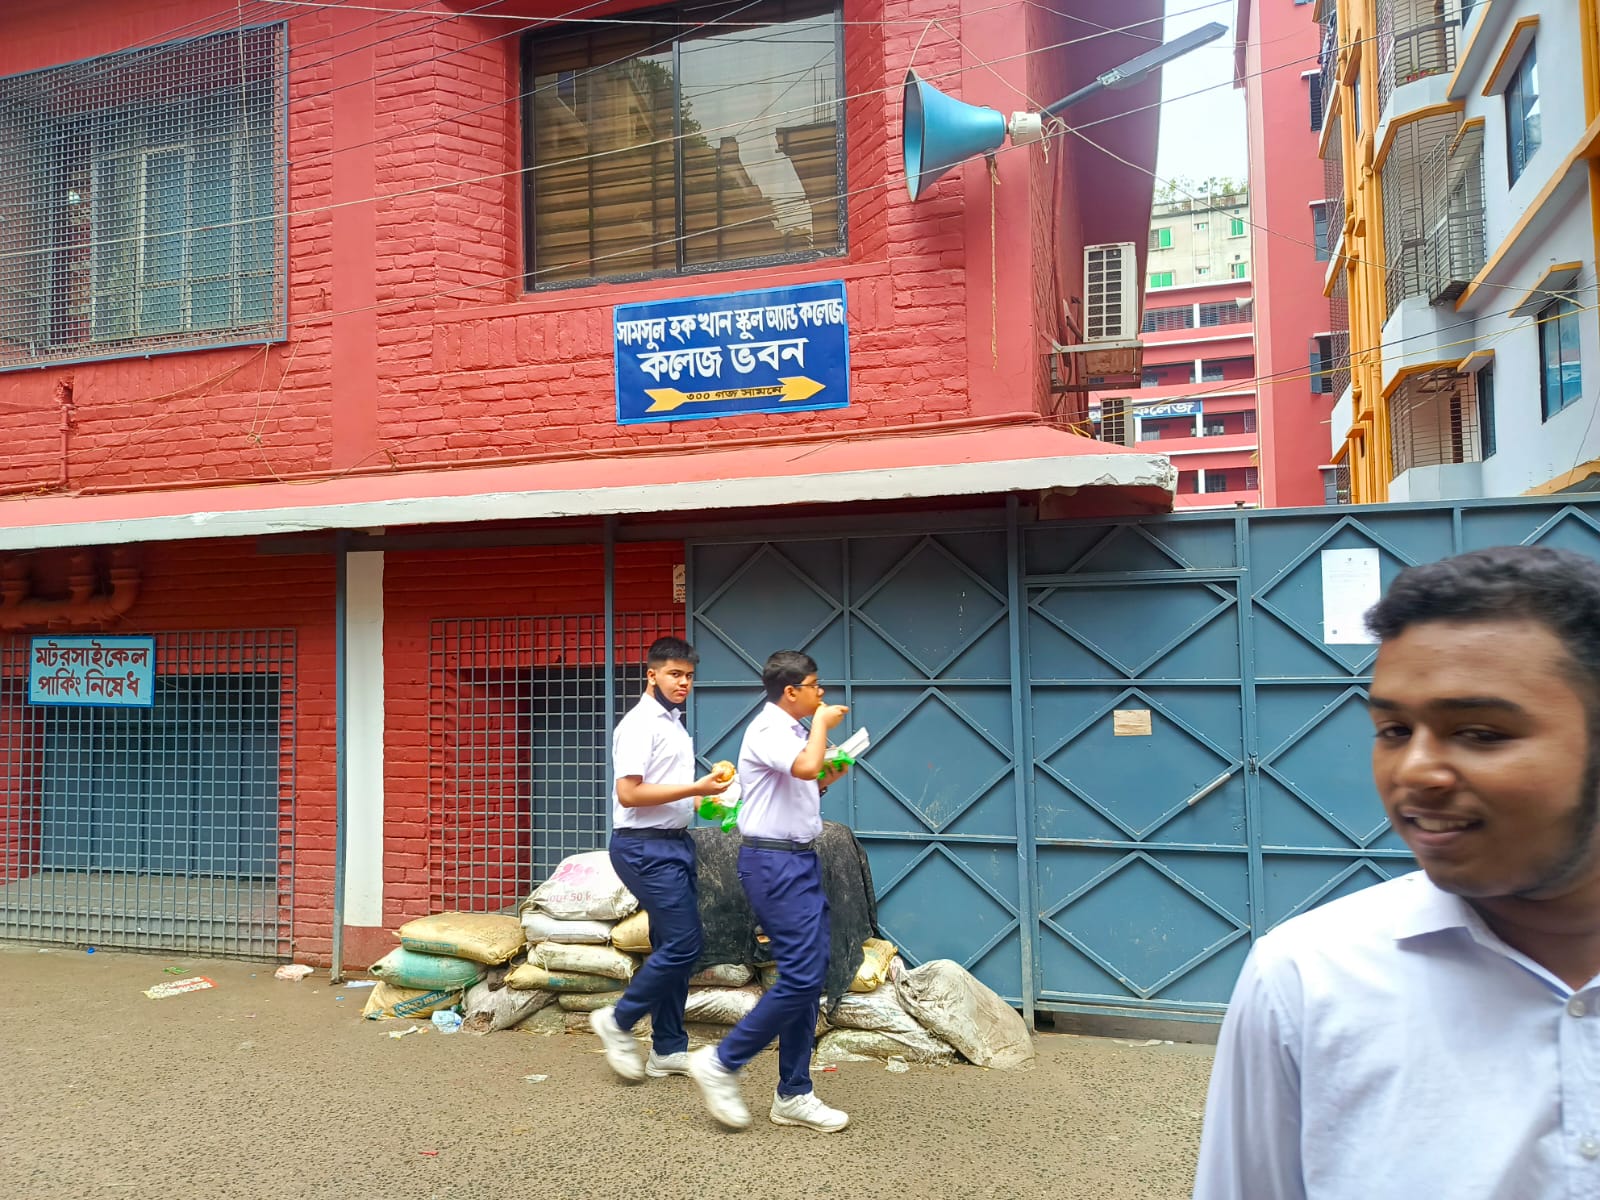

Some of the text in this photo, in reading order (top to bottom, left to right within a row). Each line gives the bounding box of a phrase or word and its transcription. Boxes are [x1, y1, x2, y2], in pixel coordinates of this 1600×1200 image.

[668, 315, 697, 344] হক
[699, 311, 734, 337] খান
[735, 308, 763, 339] স্কুল
[798, 298, 845, 326] কলেজ
[637, 338, 809, 382] কলেজ ভবন
[686, 386, 784, 401] ৩০০ গজ সামনে
[35, 640, 150, 670] মটরসাইকেল
[38, 667, 81, 697] পার্কিং
